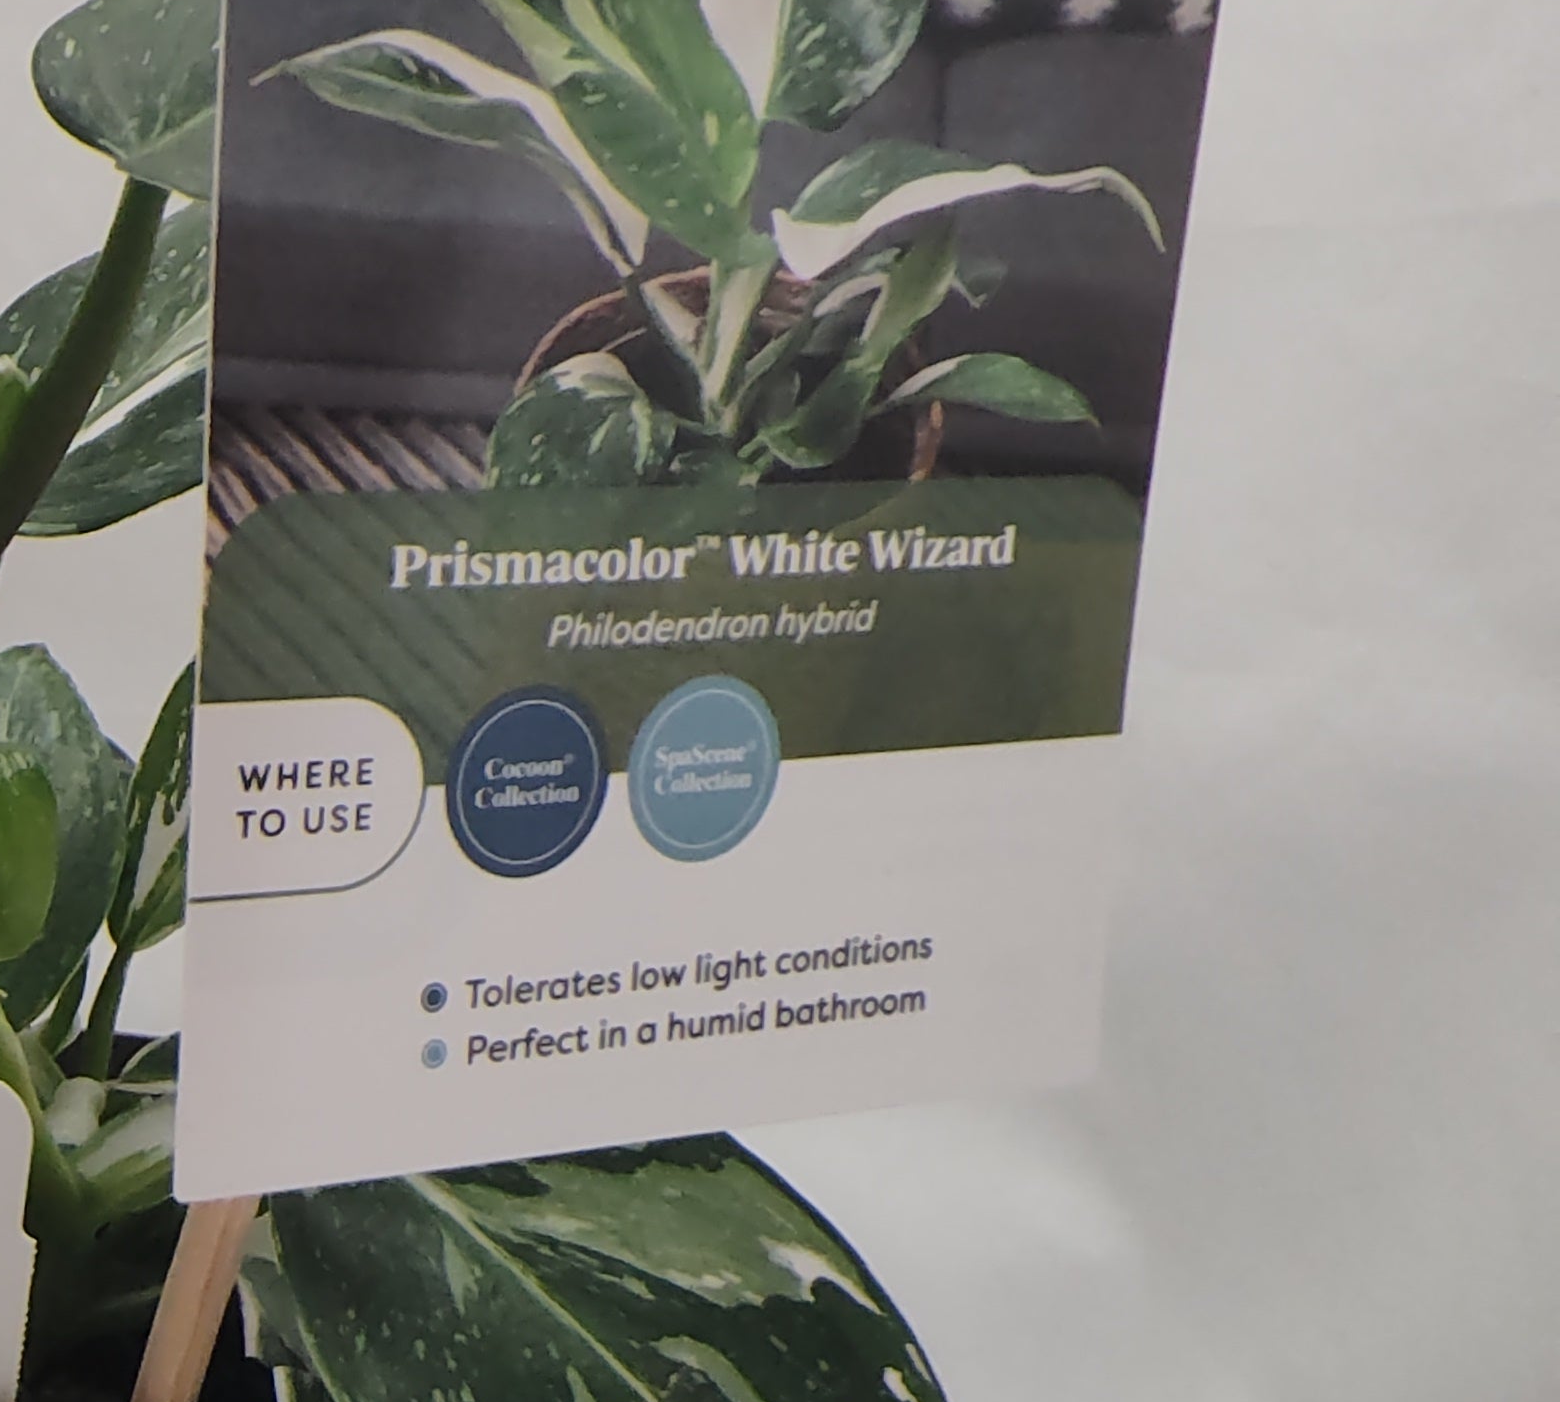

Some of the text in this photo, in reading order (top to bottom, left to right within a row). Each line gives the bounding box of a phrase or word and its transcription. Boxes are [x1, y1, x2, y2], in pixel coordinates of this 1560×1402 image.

[728, 533, 860, 577] White
[867, 524, 1017, 571] Wizard
[547, 600, 879, 648] Philodendron hybrid
[238, 758, 374, 792] WHERE
[474, 782, 581, 810] Collection
[653, 770, 753, 796] Collection
[236, 803, 373, 839] TO USE
[464, 934, 934, 1009] Tolerates low light conditions
[466, 988, 927, 1065] Perfect in a humid bathroom
